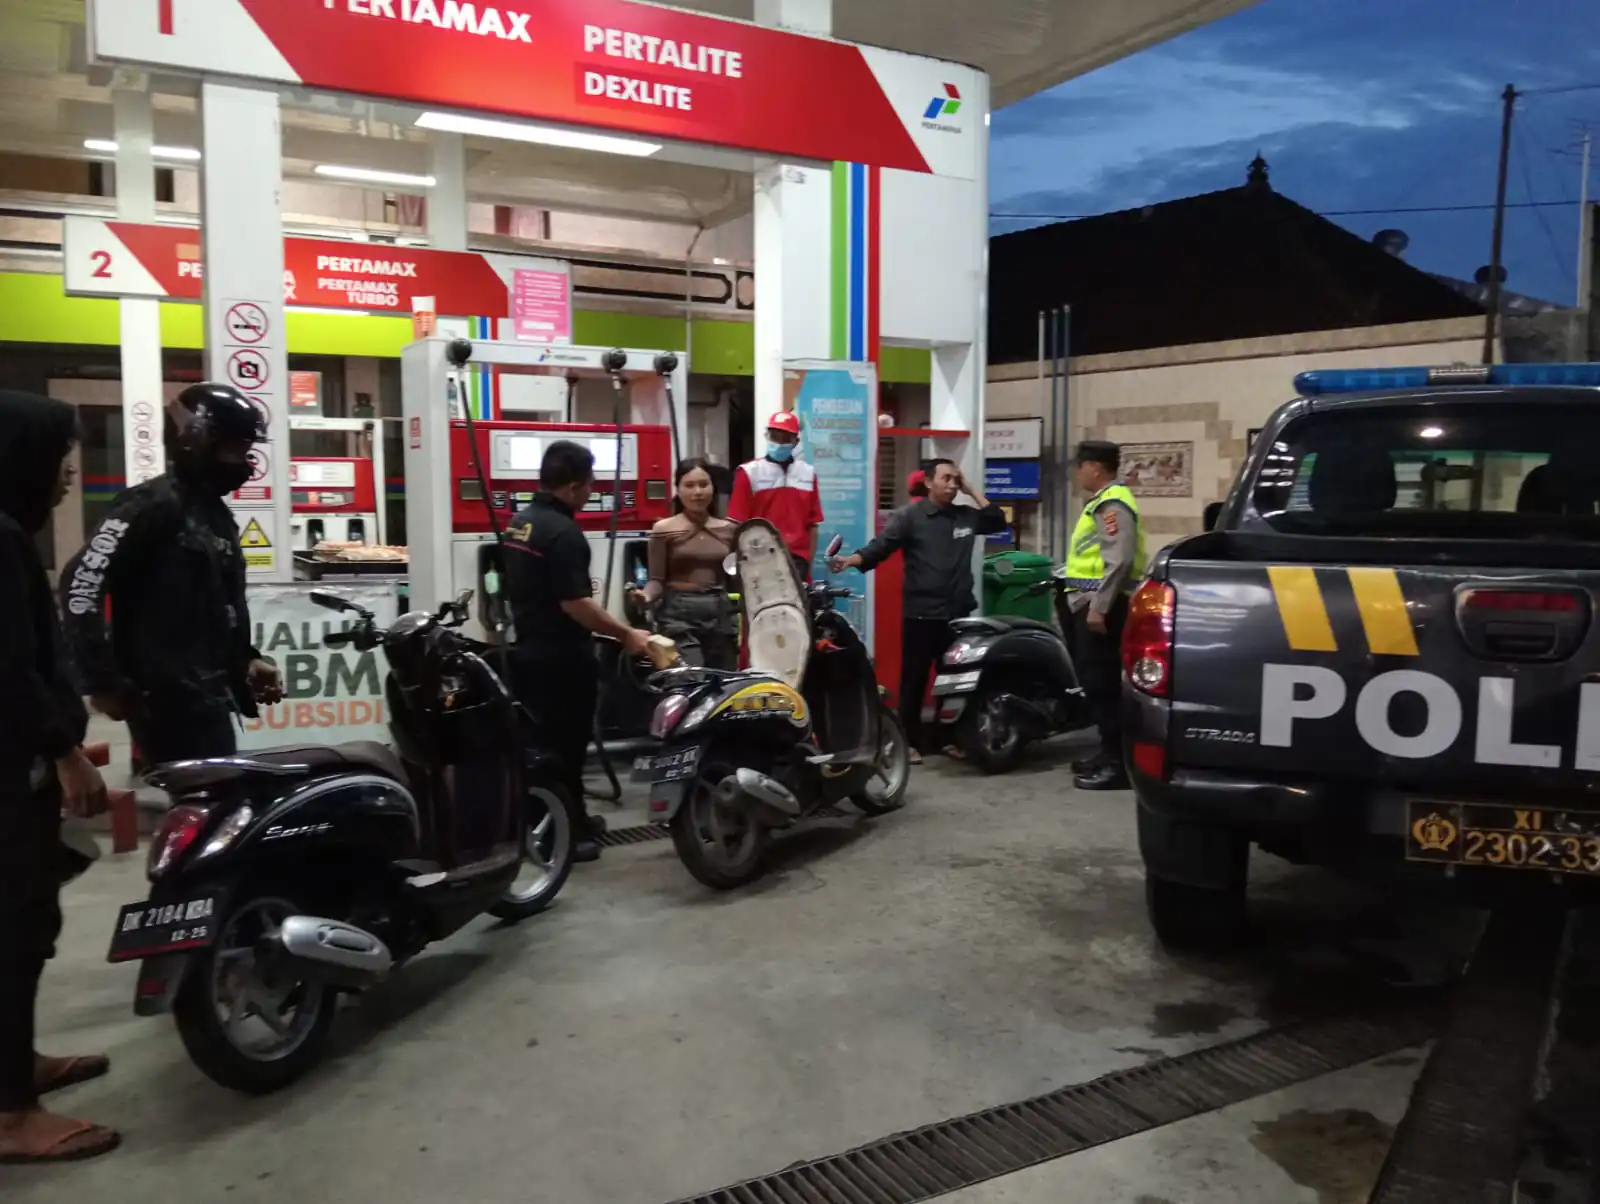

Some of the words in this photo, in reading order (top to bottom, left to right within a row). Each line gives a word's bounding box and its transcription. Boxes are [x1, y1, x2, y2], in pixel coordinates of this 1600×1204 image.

[324, 0, 532, 43] ERTAMAX
[584, 24, 742, 78] PERTALITE
[584, 71, 692, 110] DEXLITE
[90, 250, 112, 278] 2
[317, 256, 417, 277] PERTAMAX
[317, 278, 399, 294] PERTAMAX
[346, 291, 399, 306] TURBO
[250, 620, 368, 651] JALU
[262, 653, 382, 698] BM
[1184, 727, 1256, 743] STRADA
[1514, 810, 1541, 831] XI
